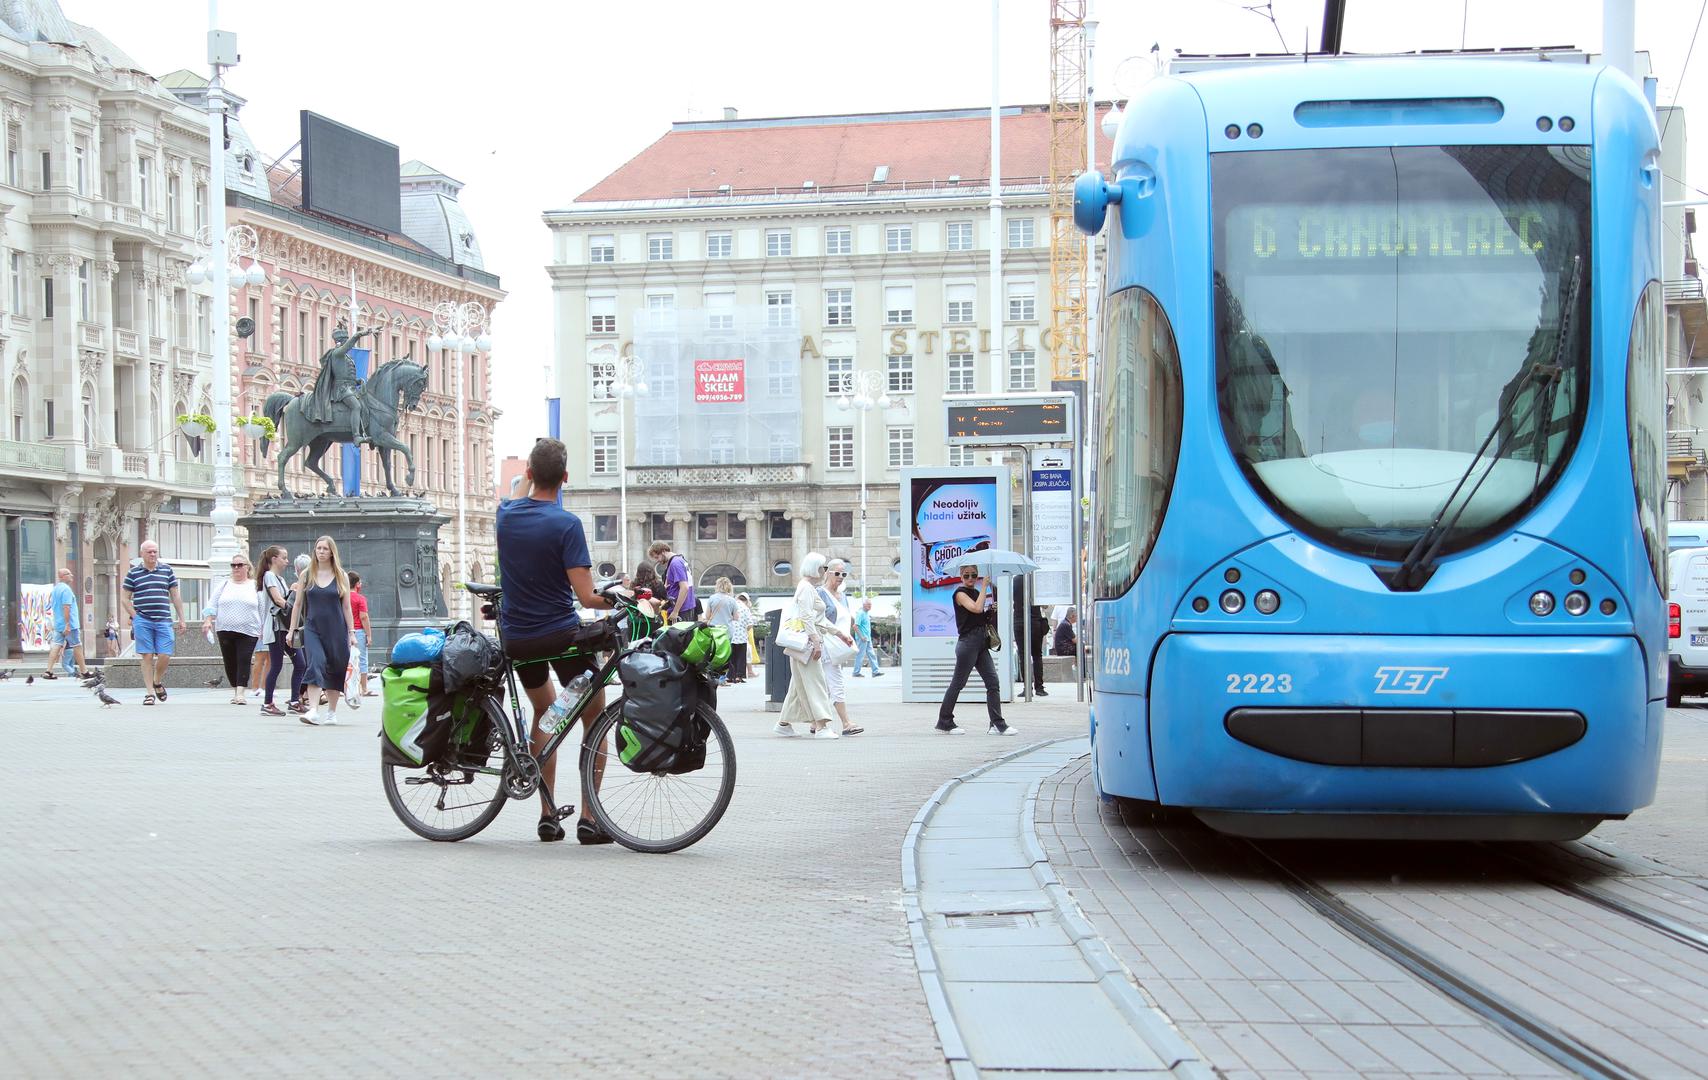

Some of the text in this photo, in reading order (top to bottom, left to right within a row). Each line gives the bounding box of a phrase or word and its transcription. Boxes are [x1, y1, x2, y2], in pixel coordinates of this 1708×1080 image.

[700, 373, 738, 382] NAJAM
[704, 383, 734, 392] SKELE
[933, 500, 979, 510] Neodoljiv
[924, 511, 987, 520] hladni užitak
[935, 547, 962, 561] CHOCO
[1105, 647, 1131, 676] 2223
[1226, 666, 1450, 695] 2223 ZET
